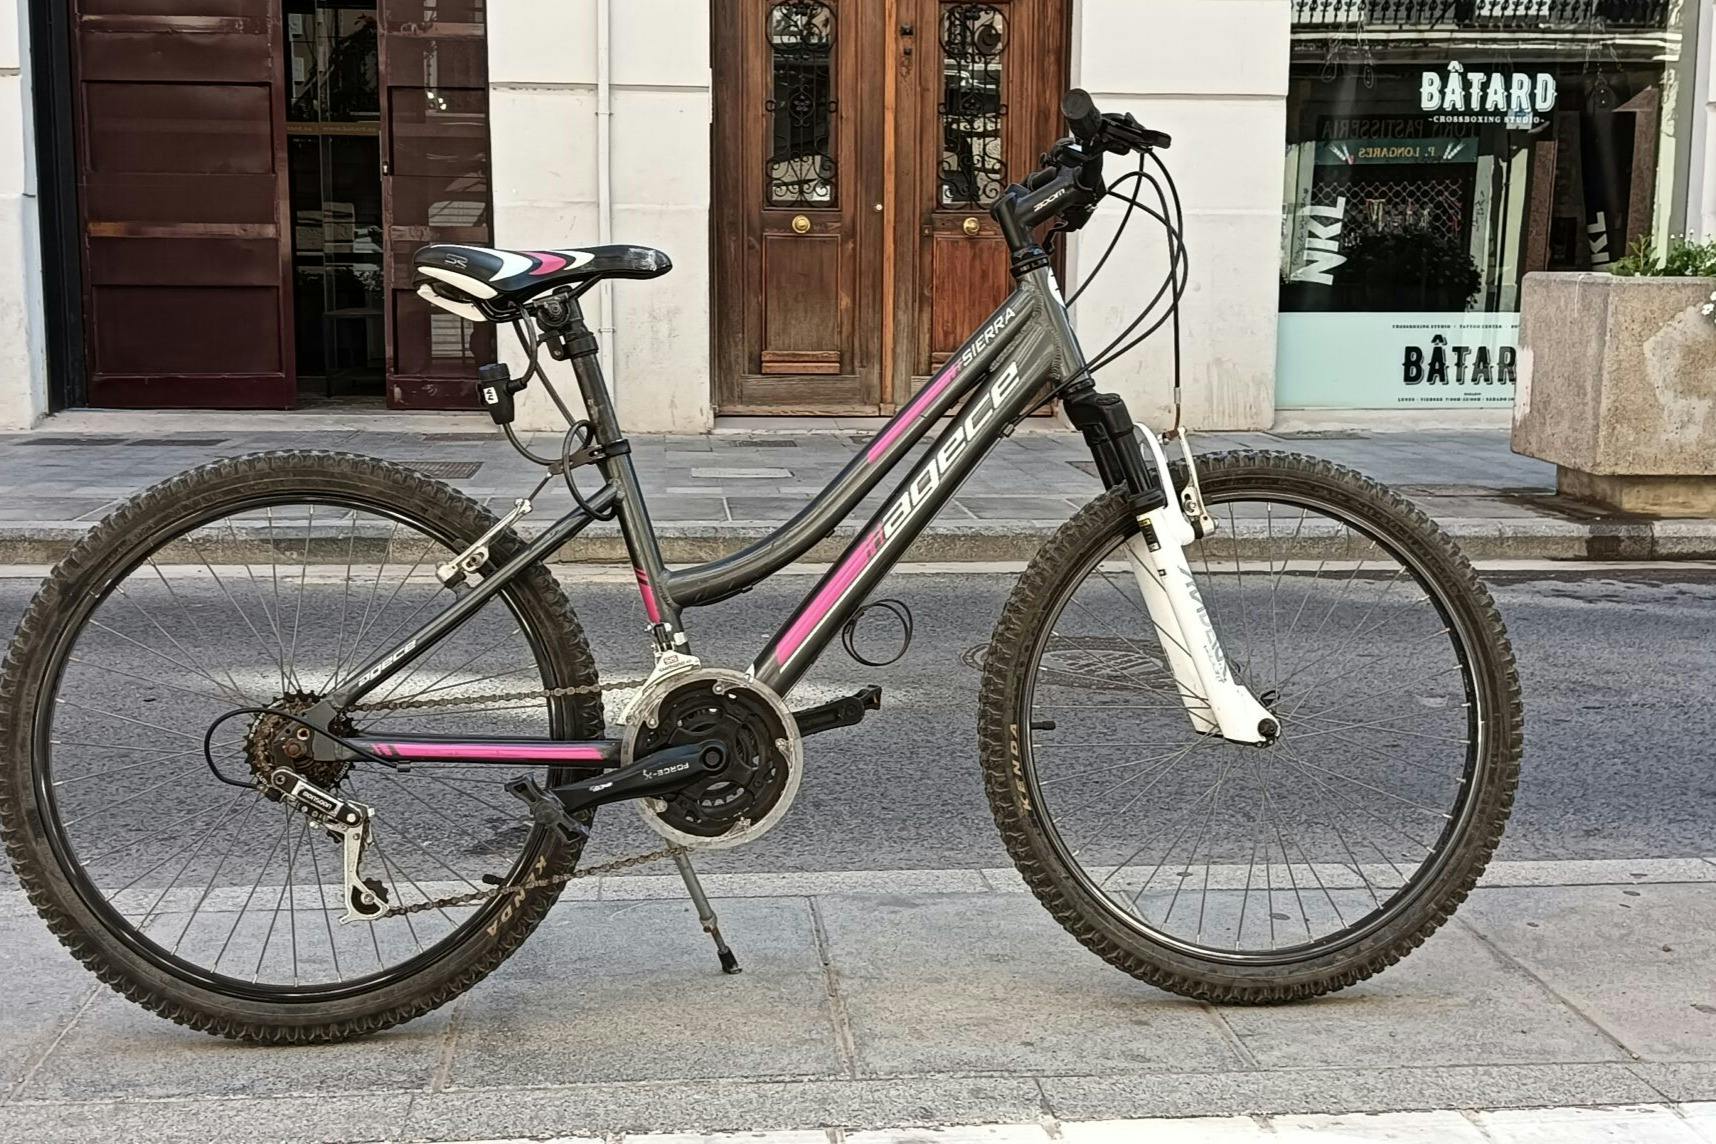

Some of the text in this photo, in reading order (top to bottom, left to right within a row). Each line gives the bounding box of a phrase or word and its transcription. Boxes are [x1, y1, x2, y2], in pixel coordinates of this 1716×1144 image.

[1420, 60, 1558, 112] BÂTARD
[962, 307, 1016, 367] SIERRA
[1010, 724, 1031, 811] KENDA
